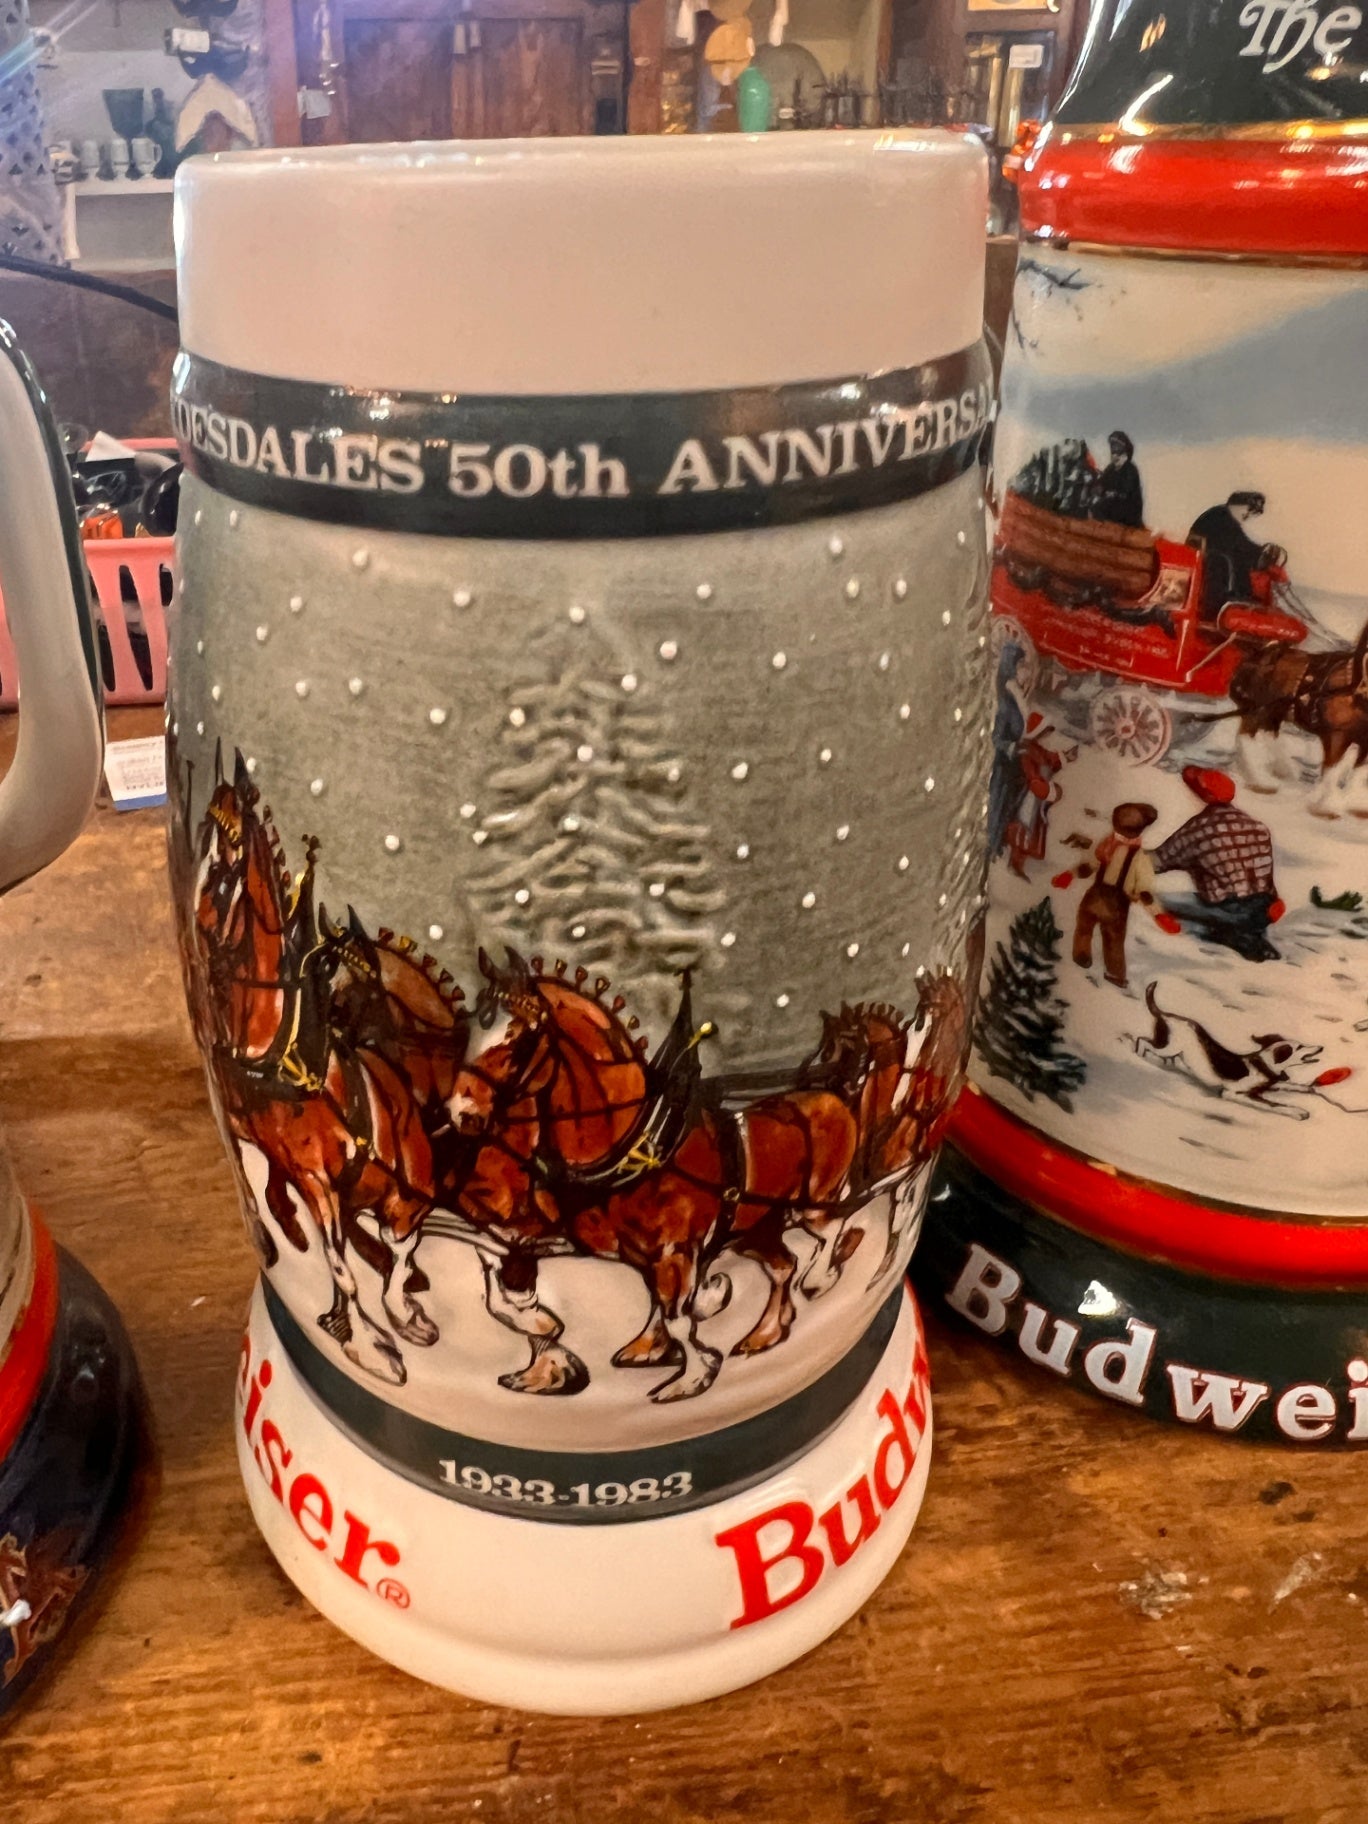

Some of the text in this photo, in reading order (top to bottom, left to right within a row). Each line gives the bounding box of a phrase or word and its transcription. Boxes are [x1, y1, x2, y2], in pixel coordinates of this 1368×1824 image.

[1239, 0, 1363, 75] The
[174, 397, 424, 494] DESDALES
[448, 443, 630, 498] 50th
[944, 1243, 1368, 1442] Budwei
[438, 1459, 693, 1508] 1933-1983
